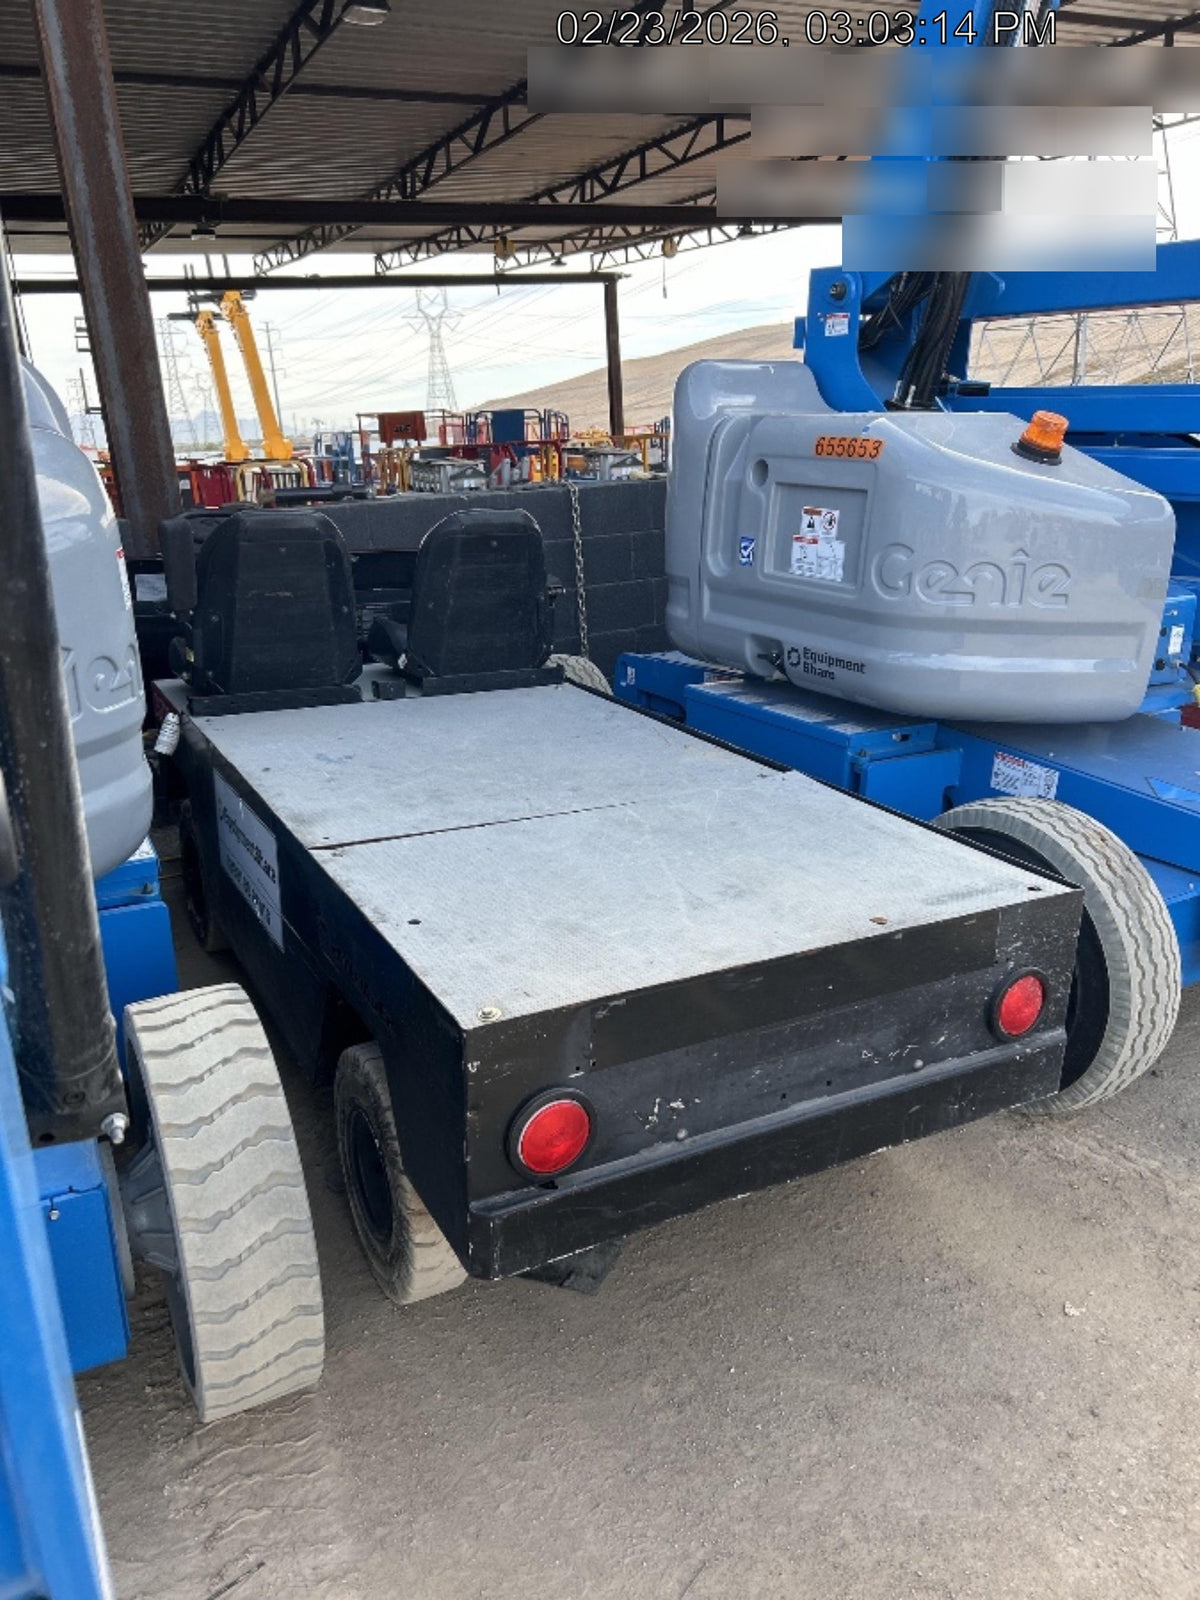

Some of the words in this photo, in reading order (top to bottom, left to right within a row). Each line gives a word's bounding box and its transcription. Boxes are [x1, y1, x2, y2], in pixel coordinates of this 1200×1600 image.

[815, 437, 882, 459] 655653
[803, 646, 866, 674] Equipment
[803, 661, 835, 680] Share
